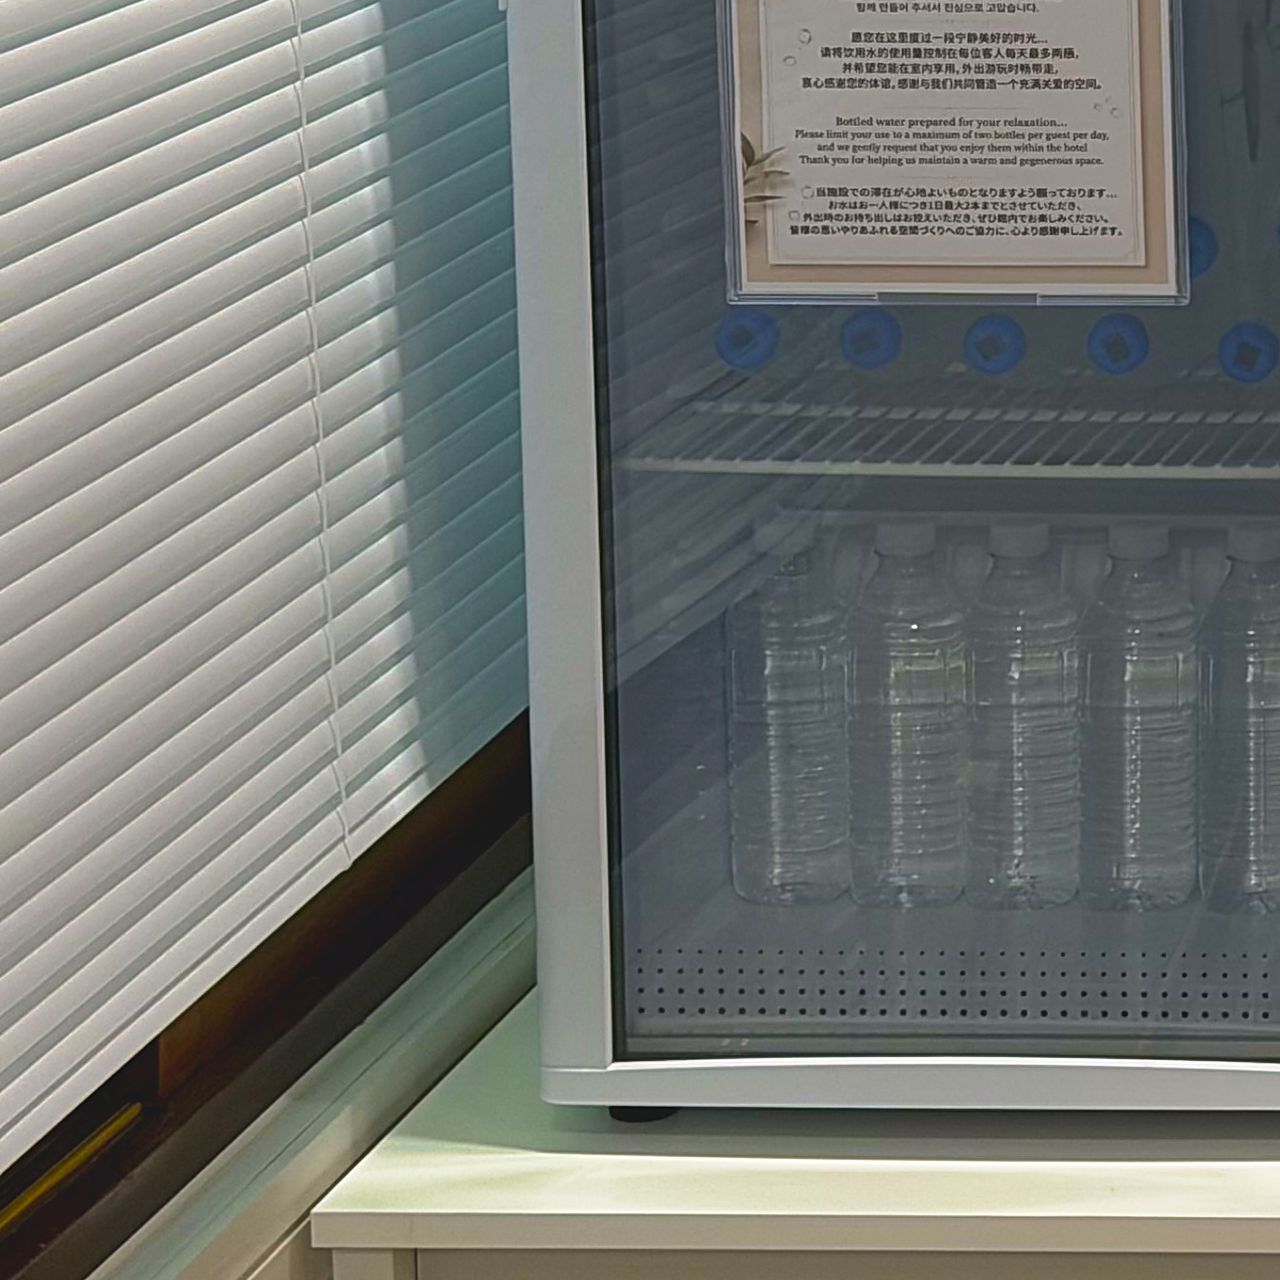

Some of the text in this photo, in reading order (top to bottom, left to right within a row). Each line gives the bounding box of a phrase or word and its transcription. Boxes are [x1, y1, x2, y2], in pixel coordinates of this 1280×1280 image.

[836, 116, 1067, 128] Bottled water prepared for your relaxation...
[795, 129, 824, 138] Please
[826, 129, 848, 138] limit
[850, 132, 872, 140] your
[893, 129, 903, 138] to
[912, 129, 960, 138] maximum
[962, 129, 973, 138] of
[974, 129, 993, 138] two
[994, 129, 1026, 138] bottles
[1028, 132, 1043, 140] per
[1045, 129, 1070, 140] guest
[1073, 132, 1088, 140] per
[1090, 129, 1109, 140] day,
[817, 143, 835, 151] and
[852, 143, 881, 153] gently
[883, 143, 917, 153] request
[920, 143, 941, 151] that
[959, 143, 985, 153] enjoy
[987, 143, 1012, 151] them
[1014, 143, 1044, 151] within
[1046, 143, 1062, 151] the
[1064, 143, 1088, 151] hotel
[798, 156, 830, 164] Thank
[851, 156, 865, 164] for
[867, 156, 903, 166] helping
[918, 156, 960, 164] maintain
[999, 156, 1017, 164] and
